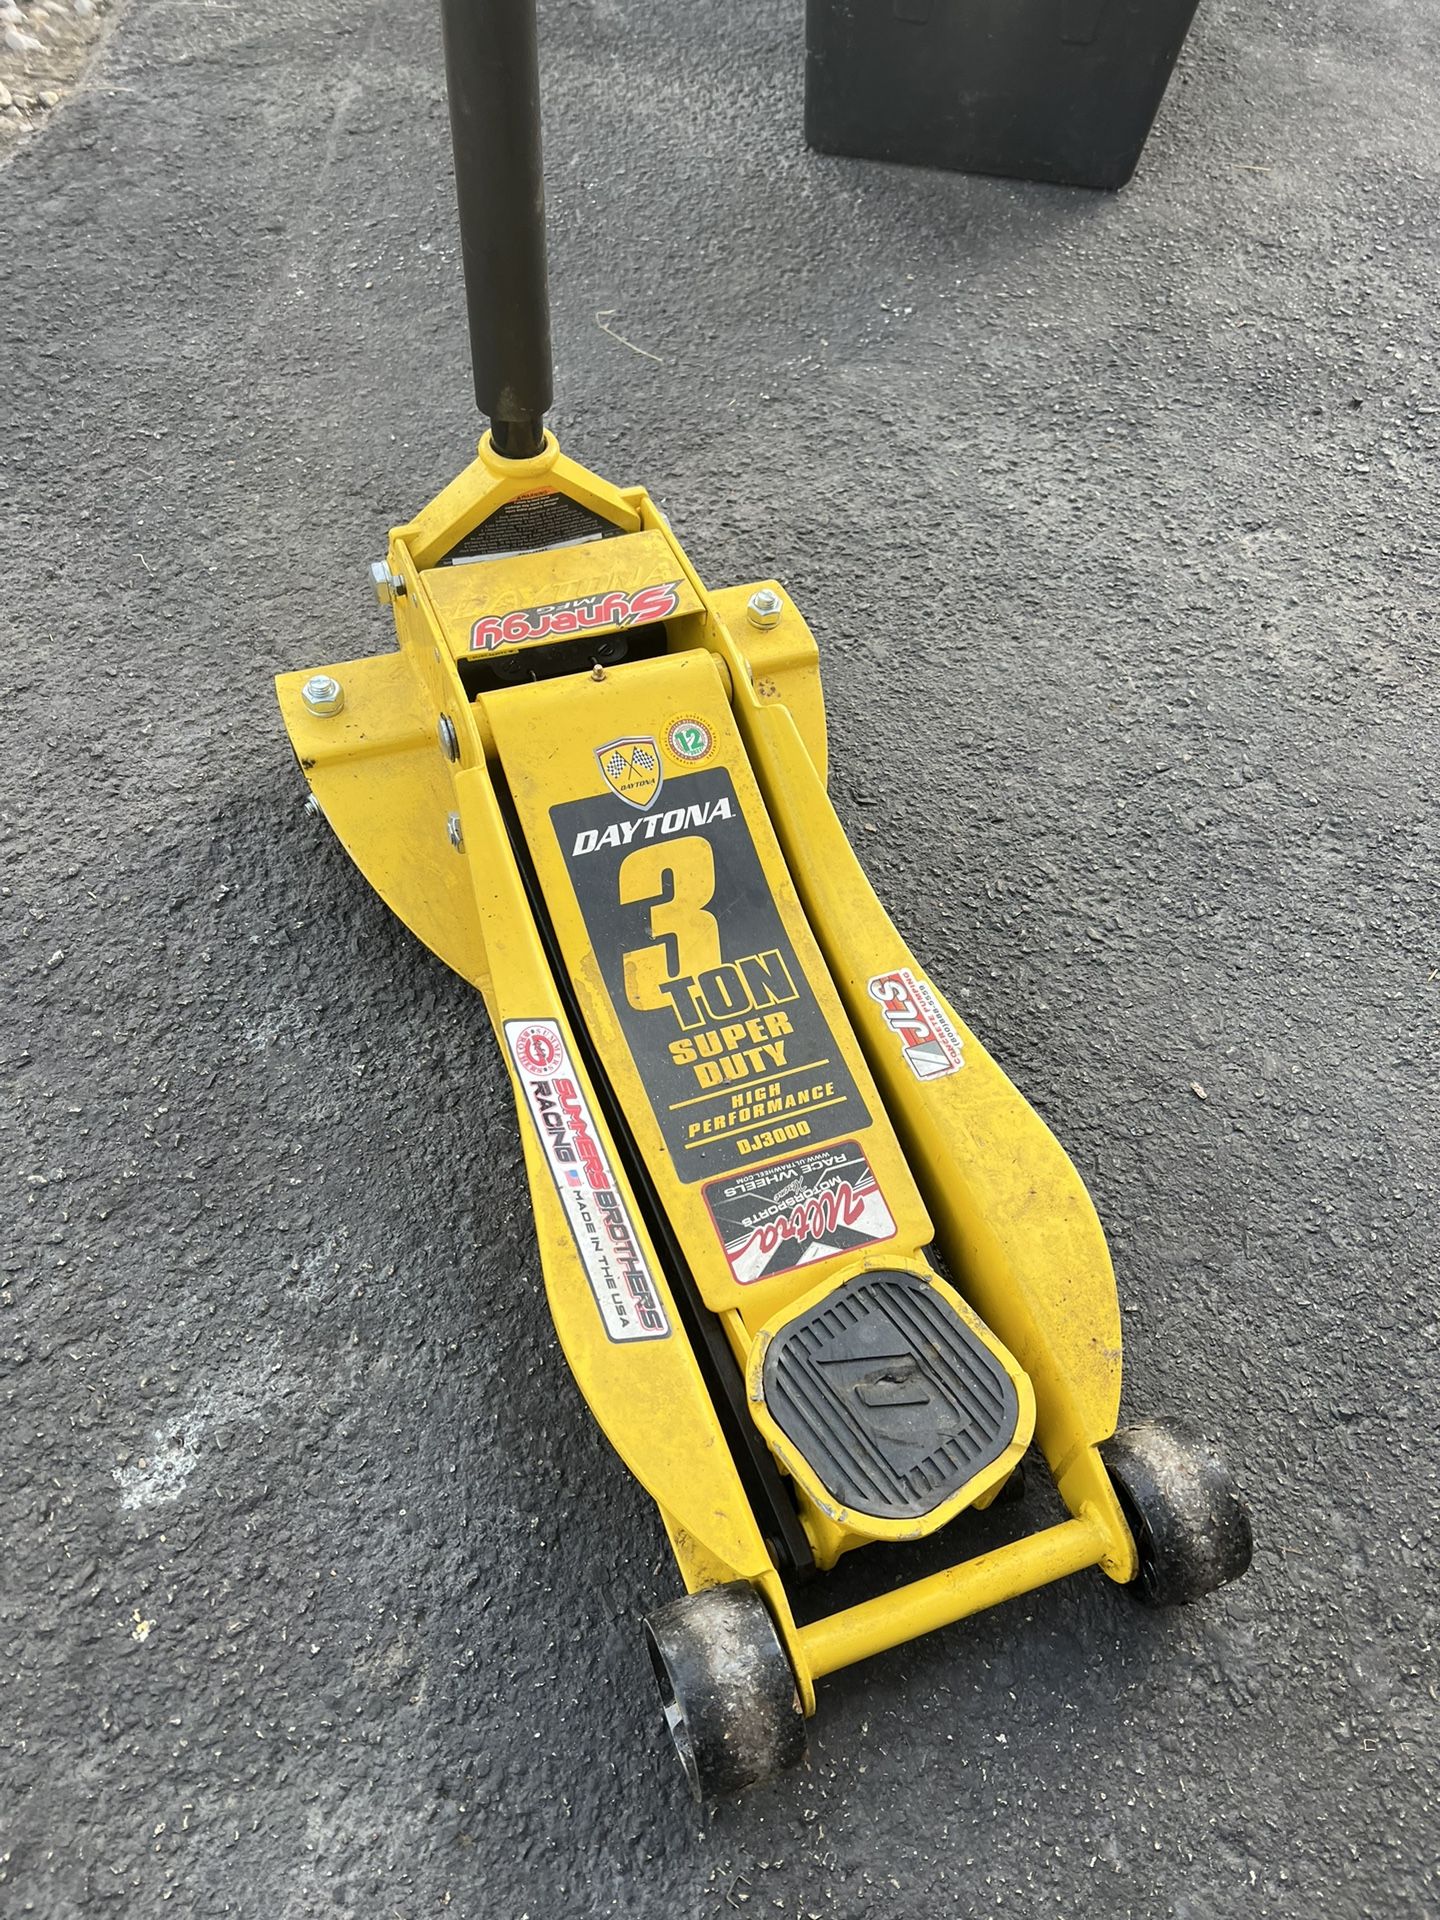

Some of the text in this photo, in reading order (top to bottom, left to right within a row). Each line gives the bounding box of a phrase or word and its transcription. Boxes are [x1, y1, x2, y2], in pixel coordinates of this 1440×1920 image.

[472, 579, 685, 650] Synergy
[536, 597, 596, 614] MFG
[674, 727, 705, 751] 12
[620, 777, 656, 792] DAYTONA
[572, 797, 733, 857] DAYTONA
[618, 835, 722, 1011] 3
[658, 949, 800, 1031] TON
[870, 980, 931, 1038] JLS
[902, 971, 961, 1065] CONCRETE PUMPING
[668, 1011, 794, 1066] SUPER
[693, 1040, 788, 1089] DUTY
[530, 1080, 577, 1164] RACING
[687, 1082, 835, 1138] PERFORMANCE
[731, 1082, 782, 1109] HIGH
[736, 1120, 811, 1155] DJ3000
[723, 1153, 848, 1198] RACE WHEELS
[736, 1151, 831, 1183] WWW.ULTRAWHEEL.COM
[552, 1078, 664, 1331] SUMMERS BROTHERS
[741, 1175, 843, 1227] MOTORSPORTS
[755, 1180, 866, 1254] Ultra
[573, 1190, 630, 1328] MADE IN THE USA
